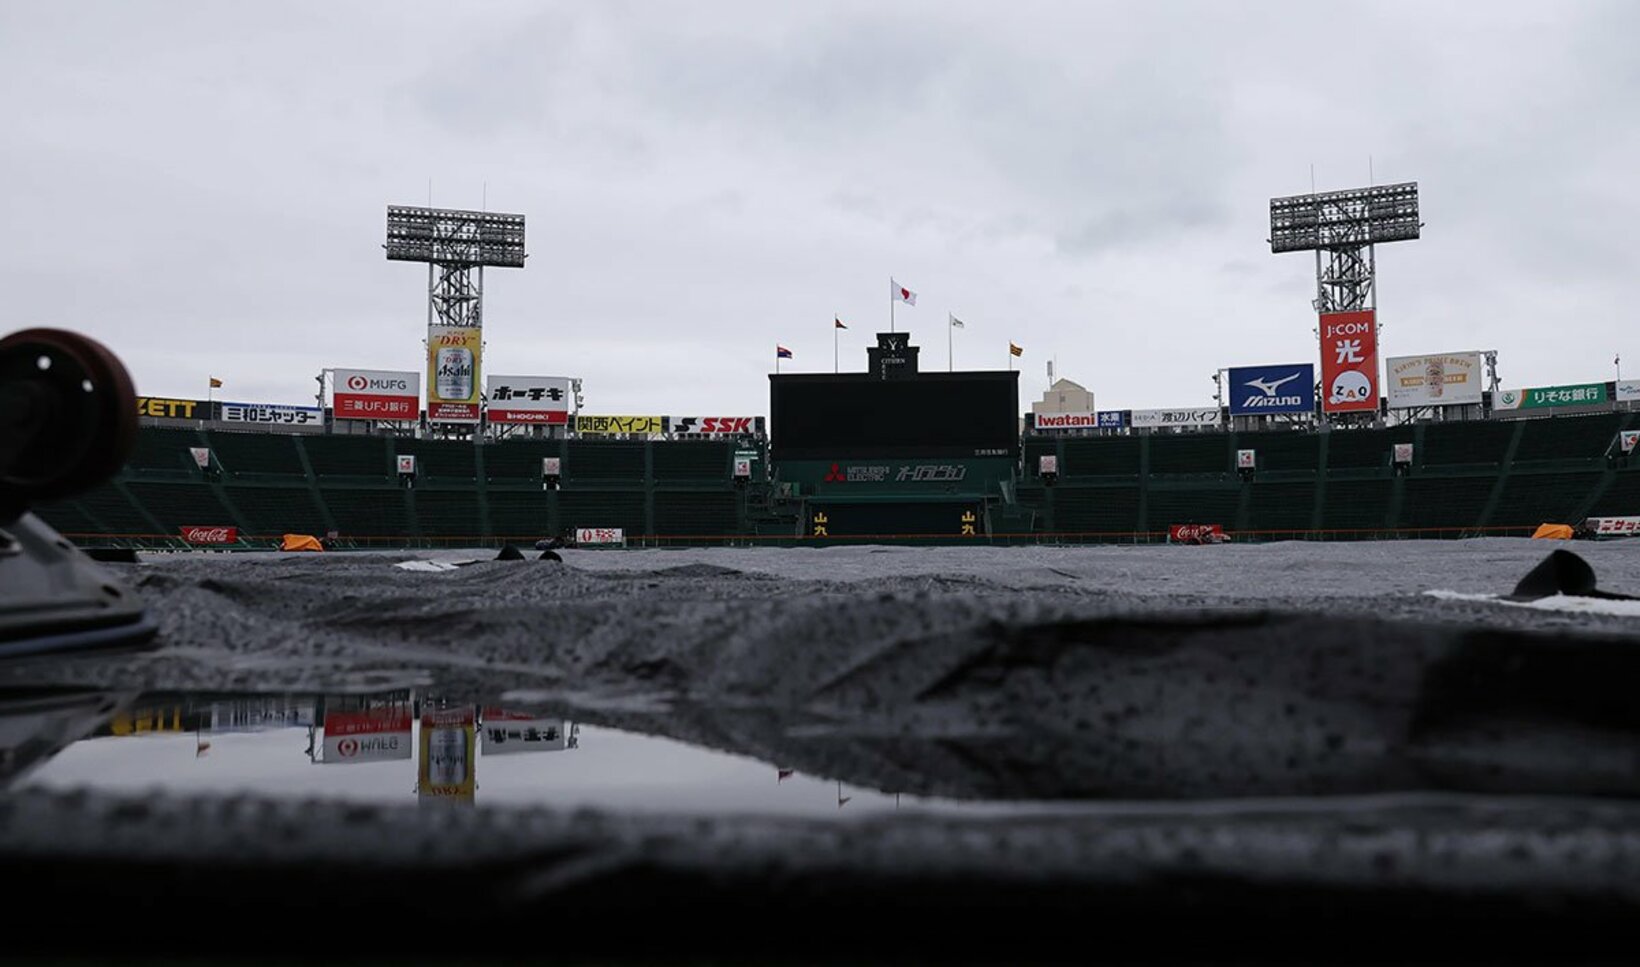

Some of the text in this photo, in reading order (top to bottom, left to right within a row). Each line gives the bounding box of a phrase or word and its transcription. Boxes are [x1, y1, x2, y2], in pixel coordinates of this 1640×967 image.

[1326, 322, 1369, 338] J:COM
[1335, 339, 1365, 364] 光
[438, 363, 471, 377] Asahi
[369, 379, 407, 390] MUFG
[492, 386, 564, 401] ホーチキ
[1534, 387, 1598, 403] りそな銀行
[227, 407, 317, 424] 三和シャッター
[577, 416, 660, 431] 関西ペイント
[1037, 413, 1096, 427] Iwatani
[700, 417, 753, 433] SSK
[814, 511, 828, 536] 山九
[961, 510, 976, 536] 山九
